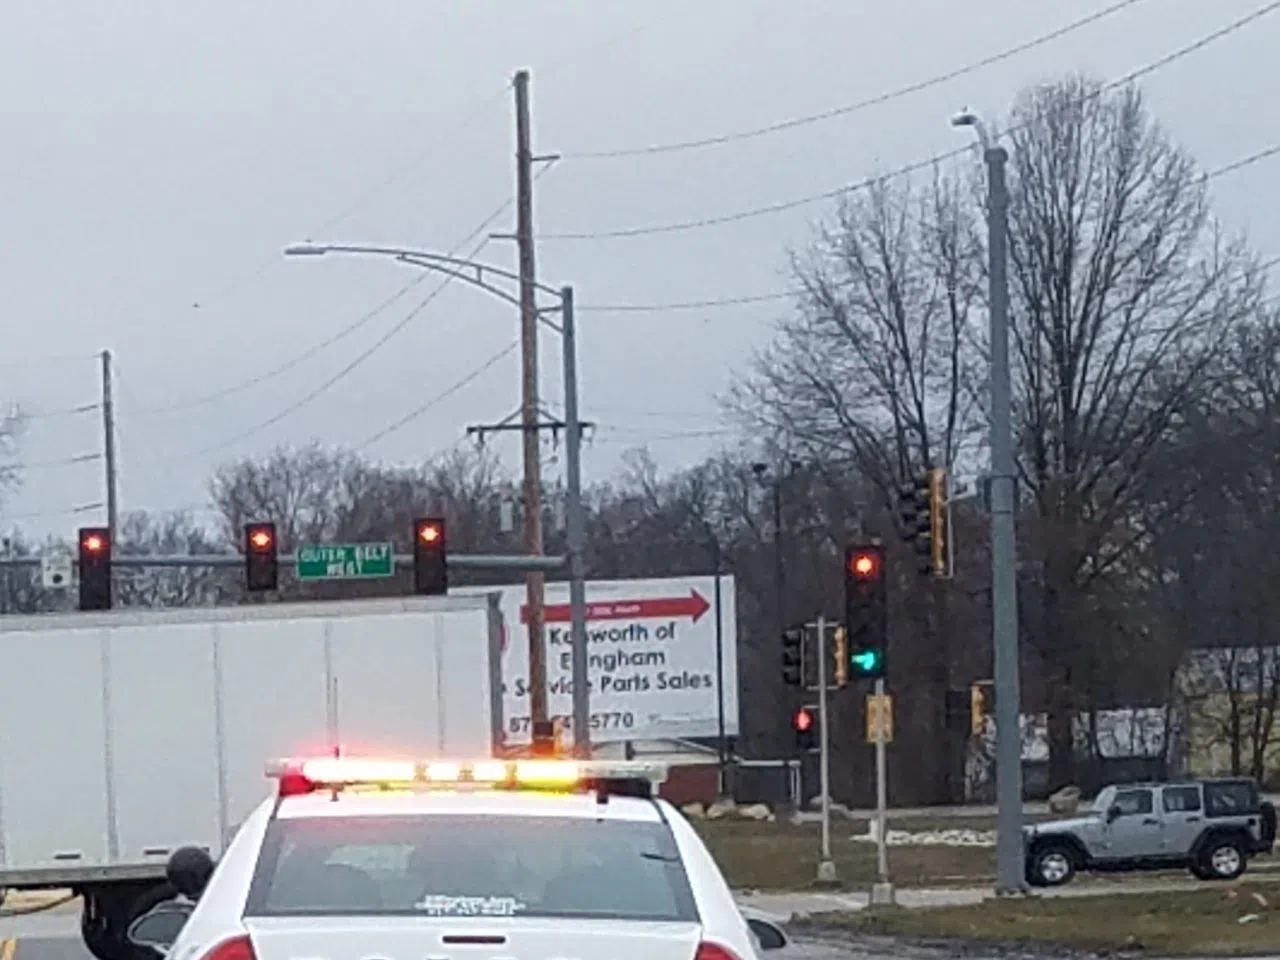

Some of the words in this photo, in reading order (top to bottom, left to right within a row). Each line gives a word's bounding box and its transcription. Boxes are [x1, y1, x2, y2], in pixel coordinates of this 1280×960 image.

[549, 624, 648, 644] Keworth
[656, 622, 676, 640] of
[561, 649, 665, 670] Engham
[601, 674, 650, 692] Parts
[657, 671, 713, 690] Sales
